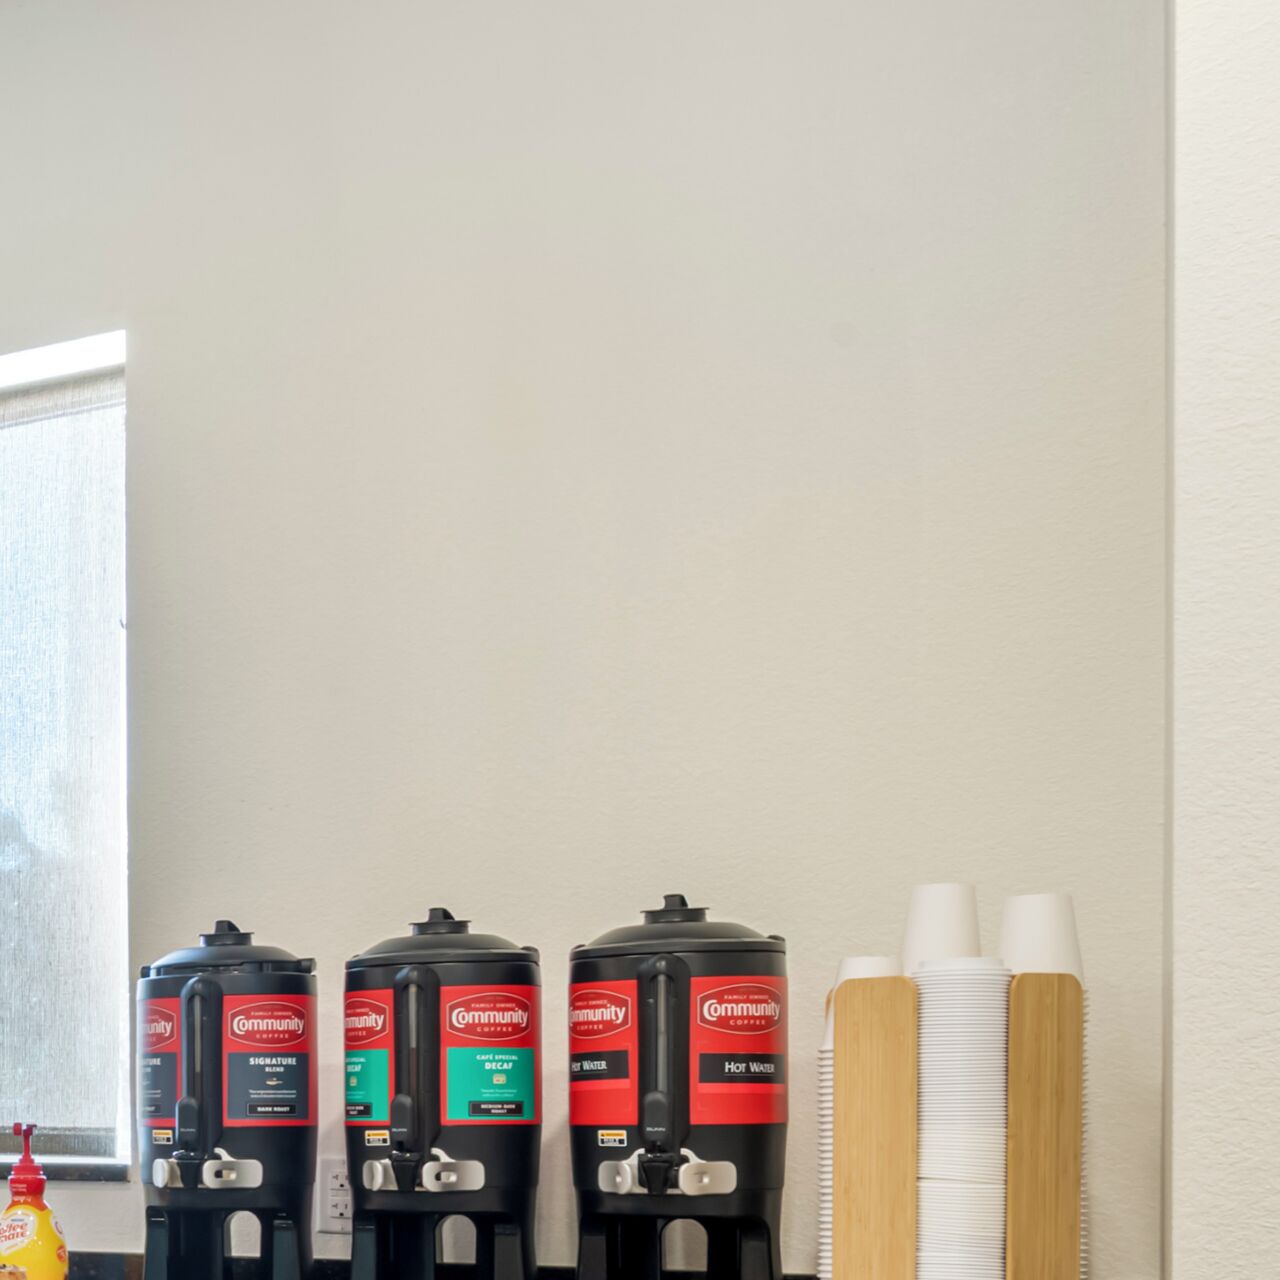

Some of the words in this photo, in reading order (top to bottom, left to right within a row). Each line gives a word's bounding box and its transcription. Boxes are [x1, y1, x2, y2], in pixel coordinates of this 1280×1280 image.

[451, 1007, 528, 1028] Community
[703, 999, 781, 1021] Community
[232, 1015, 304, 1035] Community
[249, 1056, 297, 1066] SIGNATURE
[484, 1062, 513, 1070] DECAF
